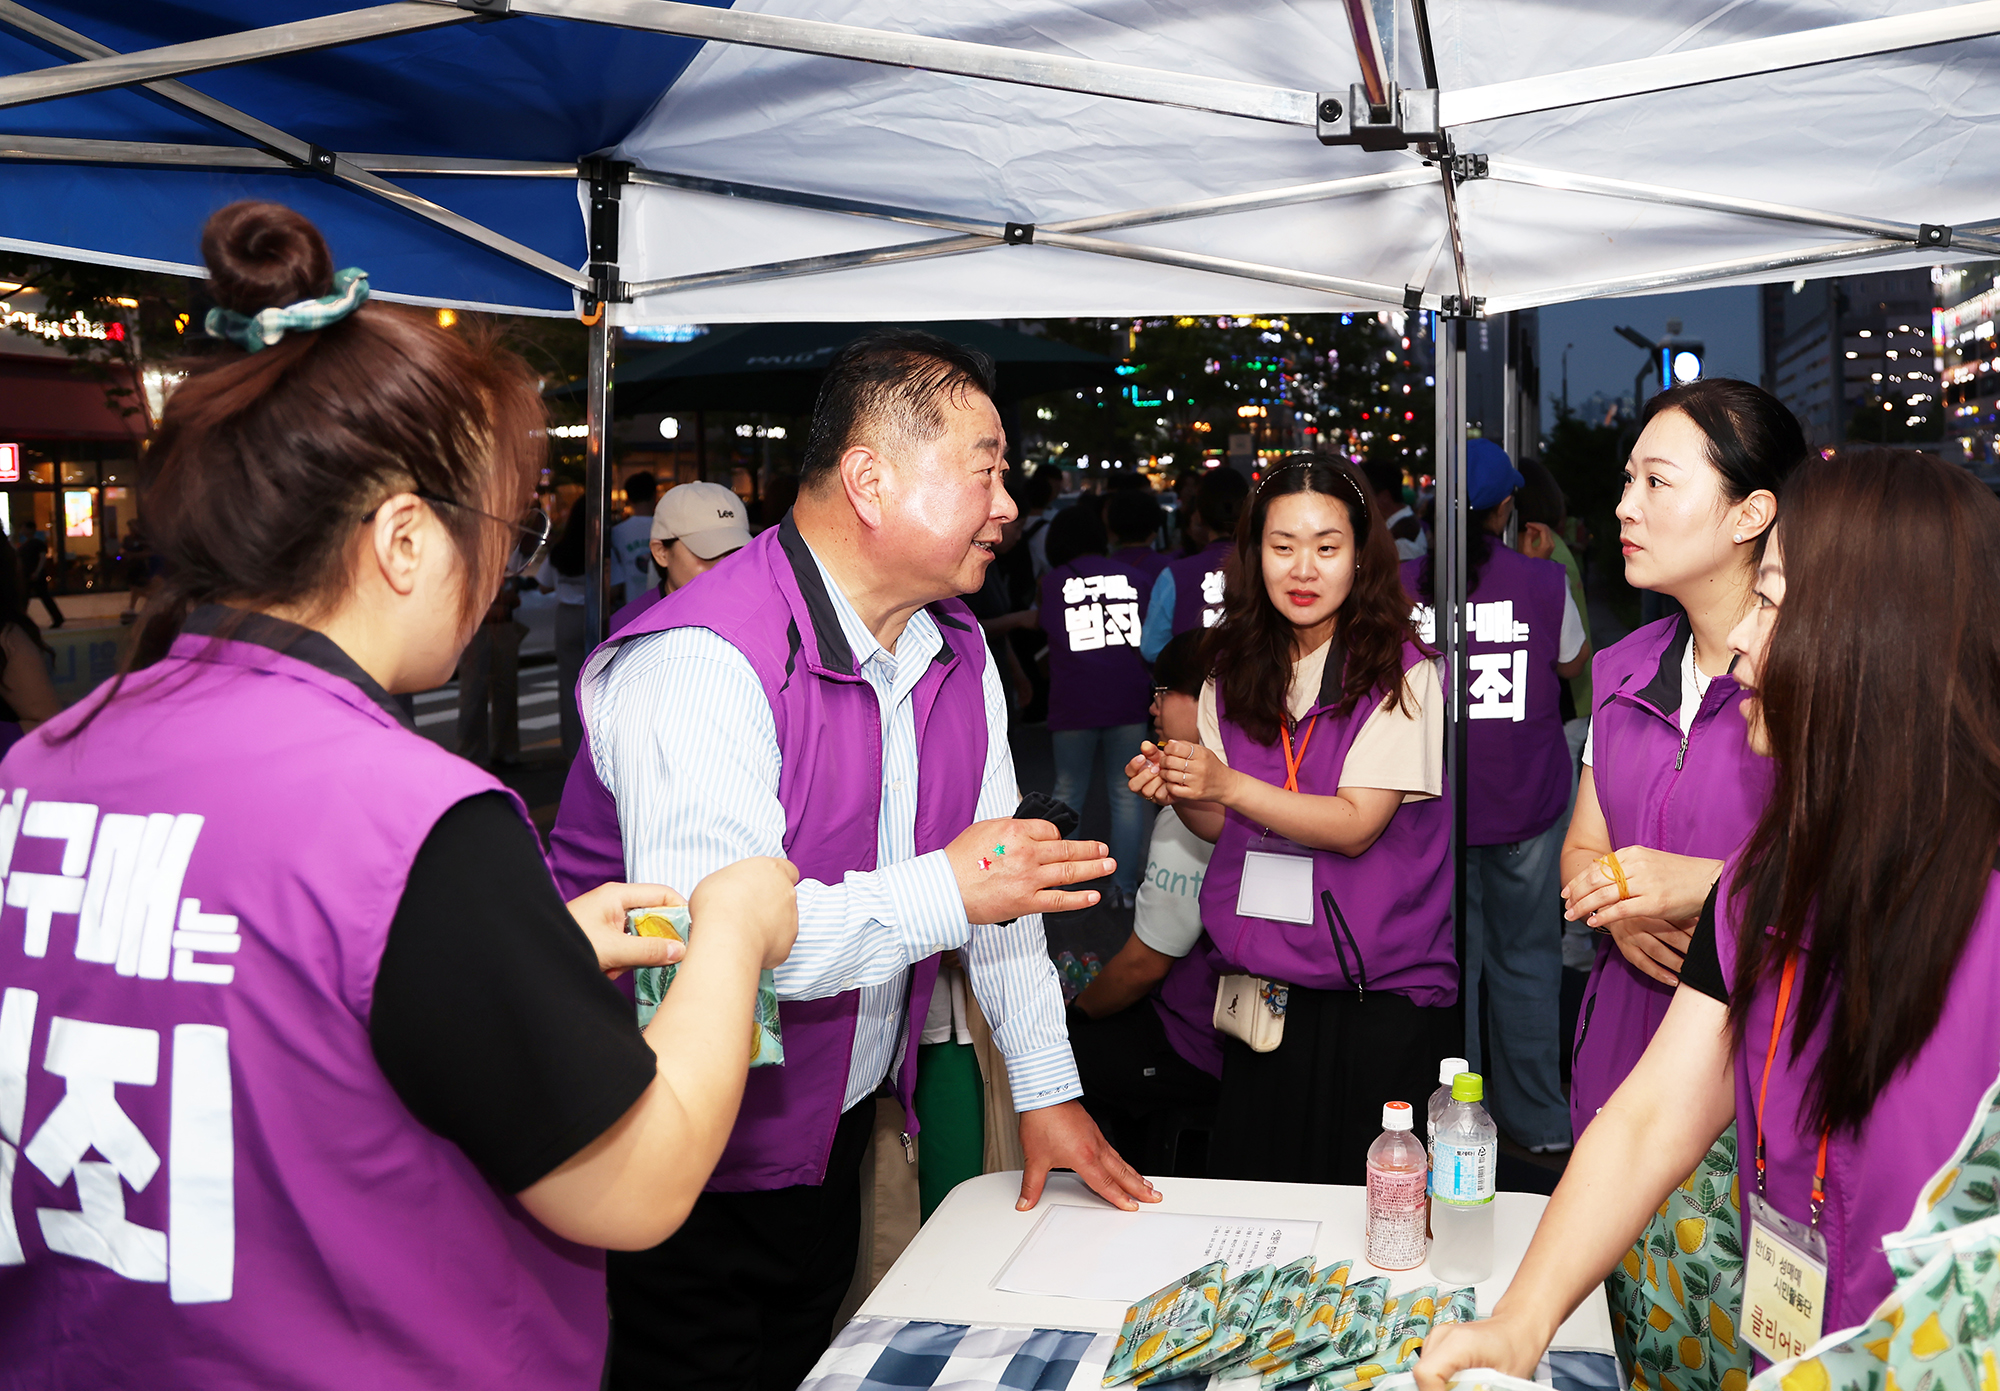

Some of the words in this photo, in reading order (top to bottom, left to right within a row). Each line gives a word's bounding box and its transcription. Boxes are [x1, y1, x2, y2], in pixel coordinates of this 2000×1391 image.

[717, 509, 735, 519] Lee
[1064, 603, 1142, 652] 범죄
[1454, 649, 1528, 723] 죄
[1779, 1257, 1803, 1288] 성매매
[1773, 1276, 1812, 1318] 시민활동단
